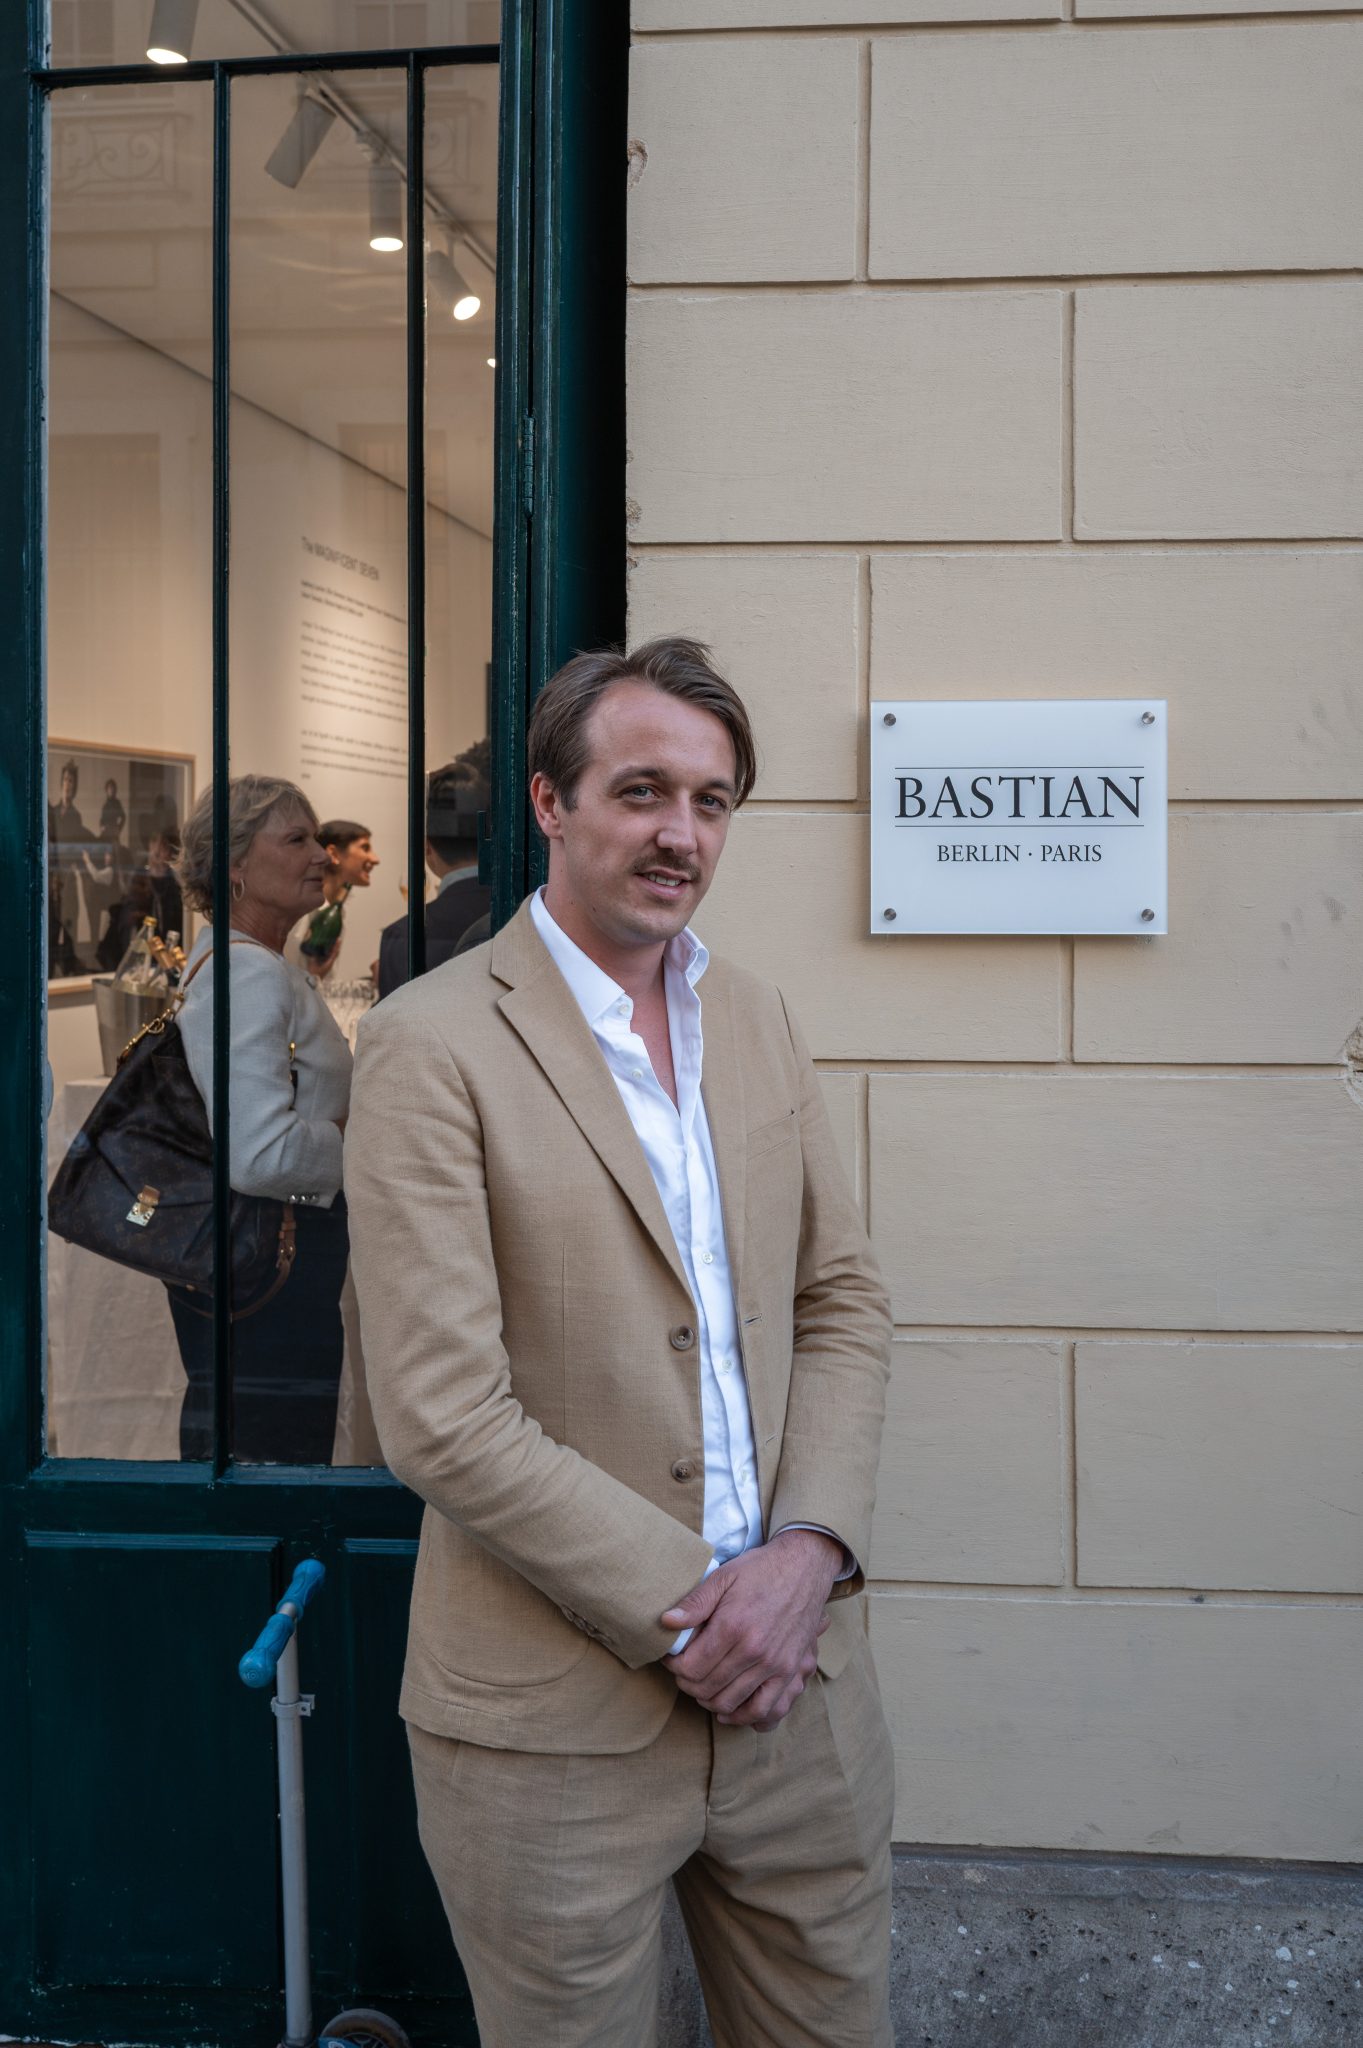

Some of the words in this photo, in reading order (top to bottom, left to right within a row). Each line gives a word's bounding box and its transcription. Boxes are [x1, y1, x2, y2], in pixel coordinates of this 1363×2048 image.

[895, 775, 1144, 819] BASTIAN
[937, 844, 1021, 862] BERLIN
[1040, 844, 1102, 862] PARIS
